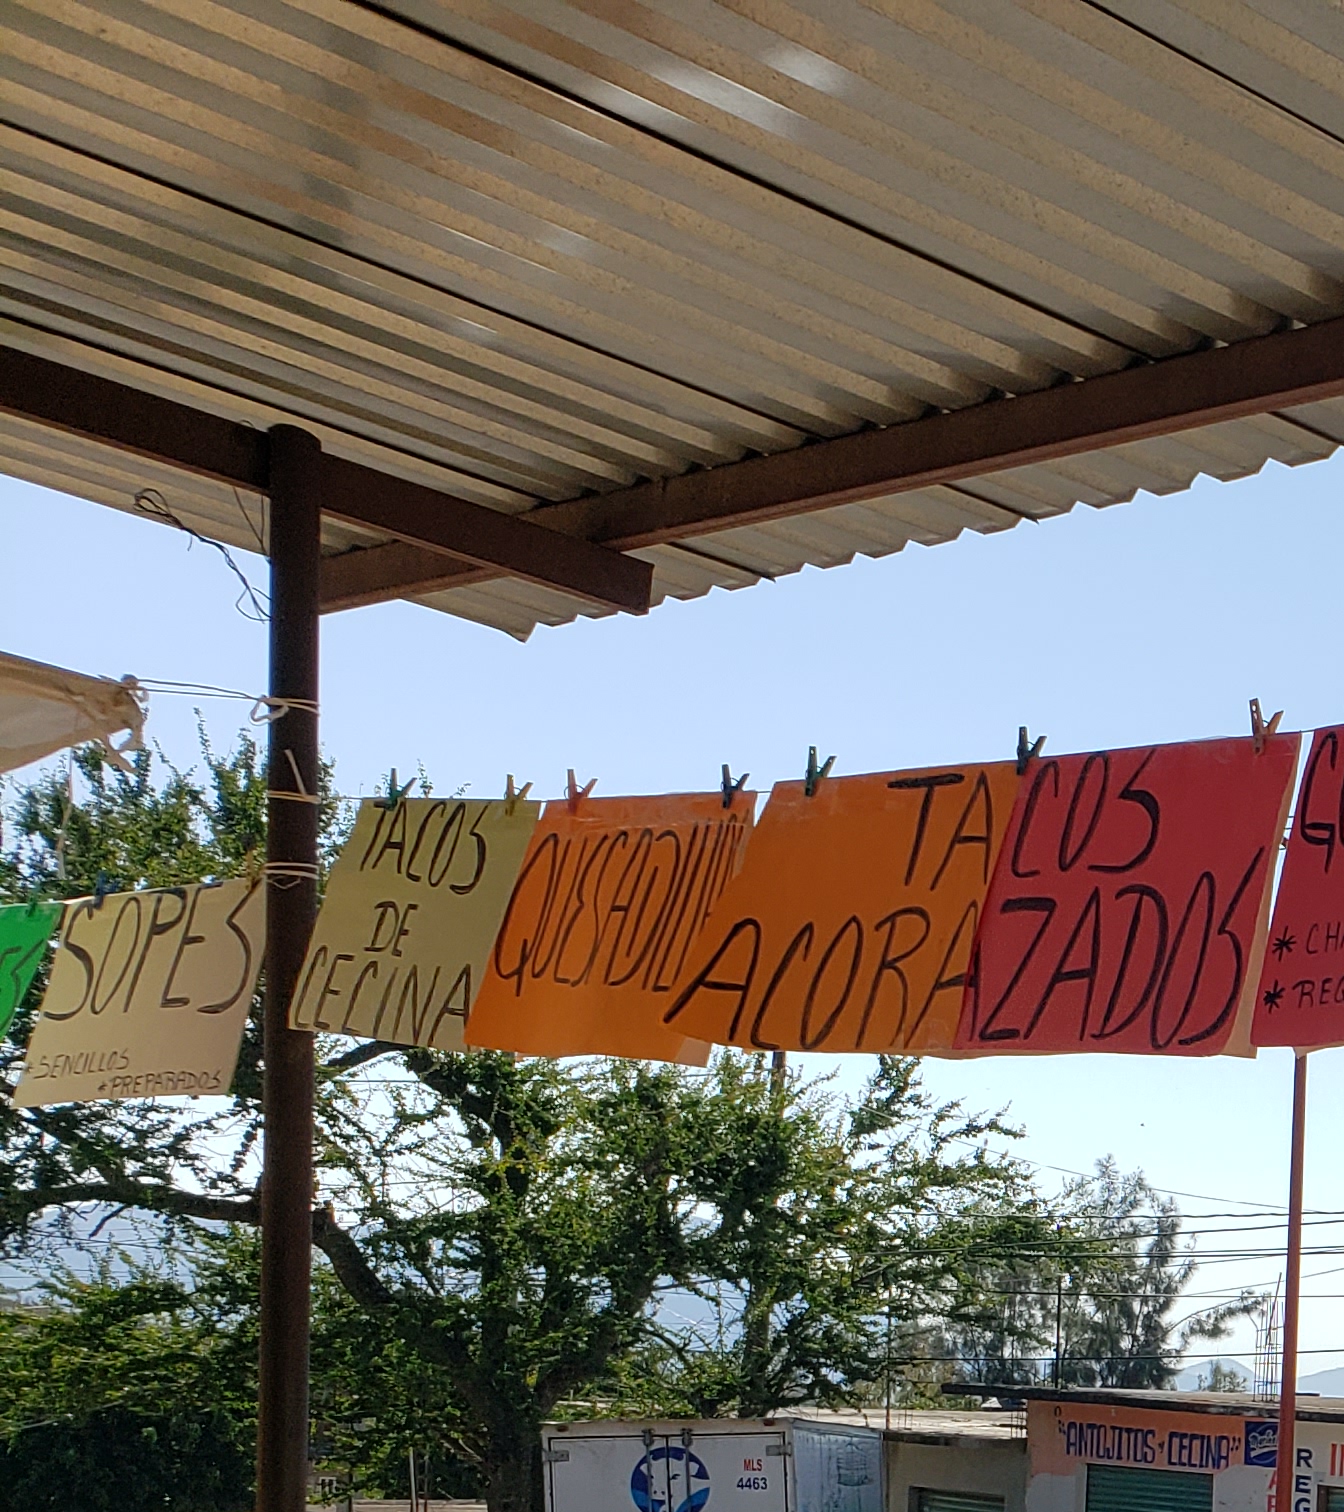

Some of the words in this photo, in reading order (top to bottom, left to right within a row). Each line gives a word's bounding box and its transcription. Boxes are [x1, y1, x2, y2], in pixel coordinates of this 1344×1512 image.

[359, 798, 490, 896] TACOS
[43, 880, 262, 1021] SOPES
[364, 901, 419, 958] DE
[295, 945, 471, 1046] CECINA
[33, 1048, 131, 1080] SENCILLOS
[111, 1069, 223, 1096] PREPARADOS
[736, 1477, 768, 1490] 4463
[743, 1459, 763, 1472] MLS
